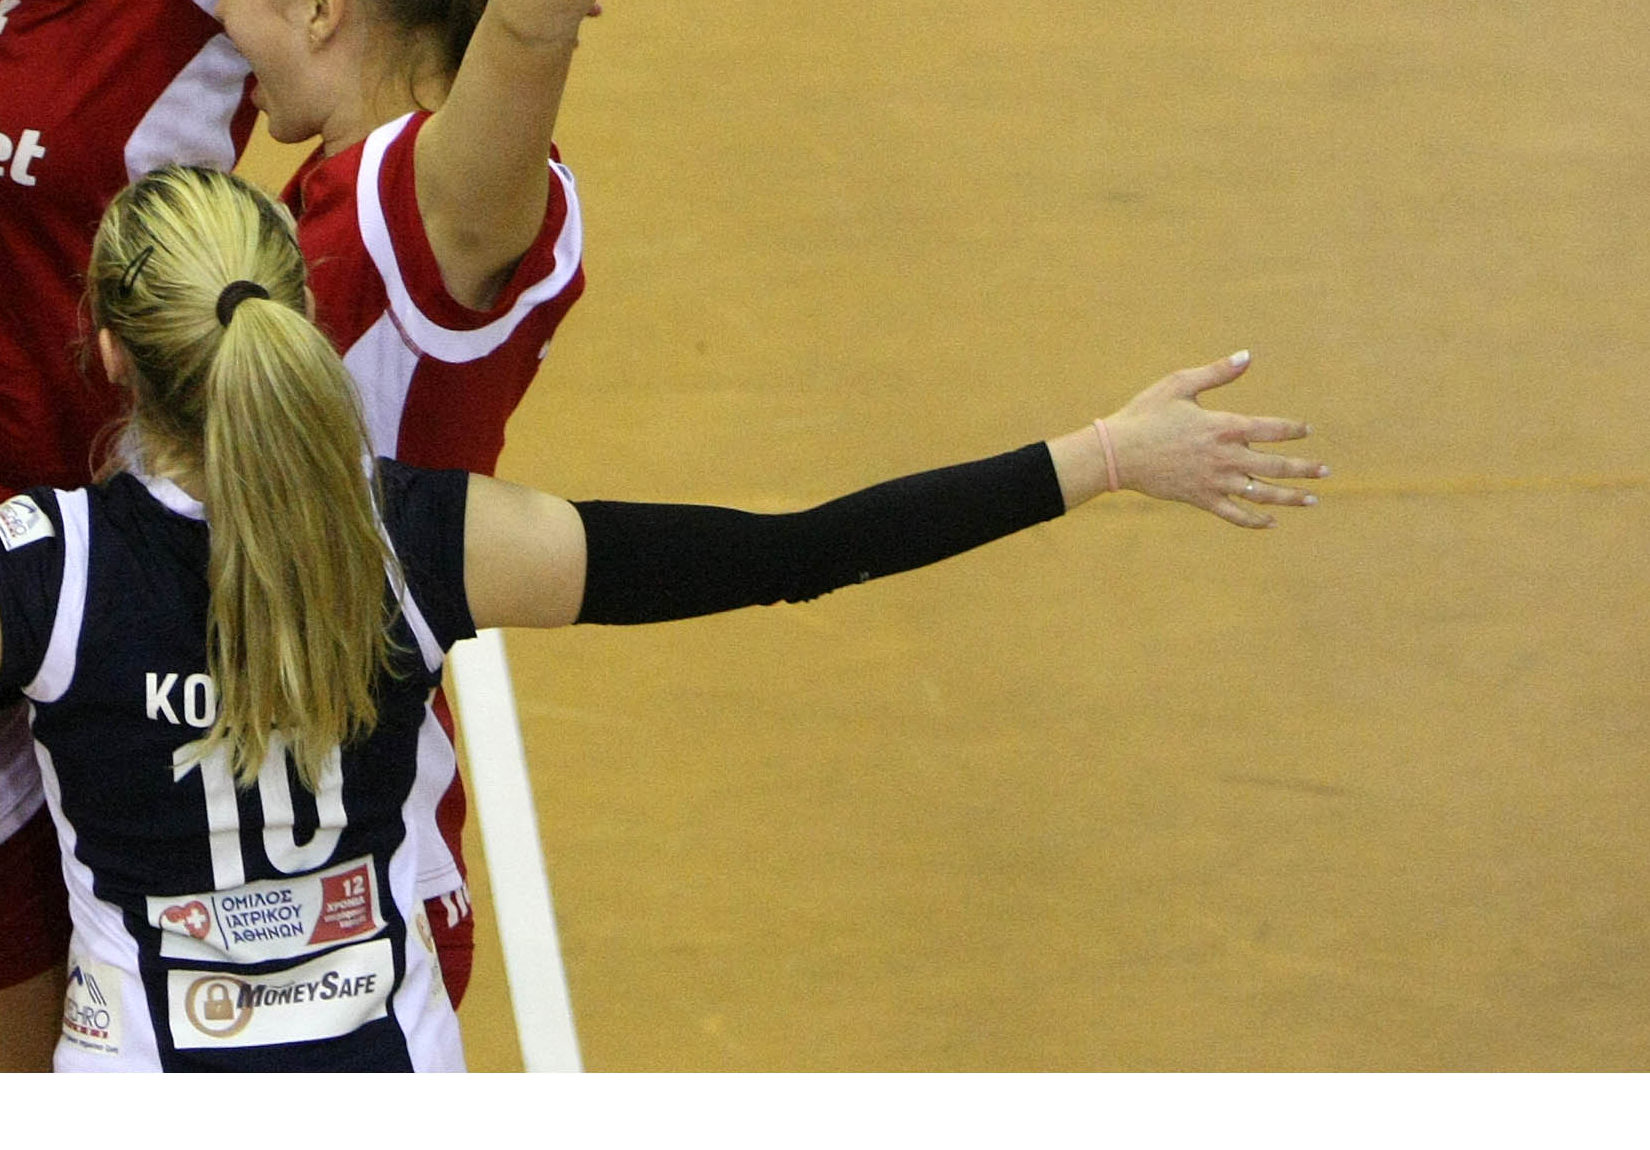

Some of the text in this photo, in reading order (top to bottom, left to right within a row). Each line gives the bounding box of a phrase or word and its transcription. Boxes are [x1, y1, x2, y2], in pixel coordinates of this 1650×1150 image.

[145, 671, 217, 729] KO
[172, 727, 349, 892] 10
[342, 875, 366, 897] 12
[221, 889, 293, 913] ΟΜΙΛΟΣ
[225, 904, 303, 929] ΙΑΤΡΙΚΟΥ
[233, 921, 304, 944] ΑΘΗΝΩΝ
